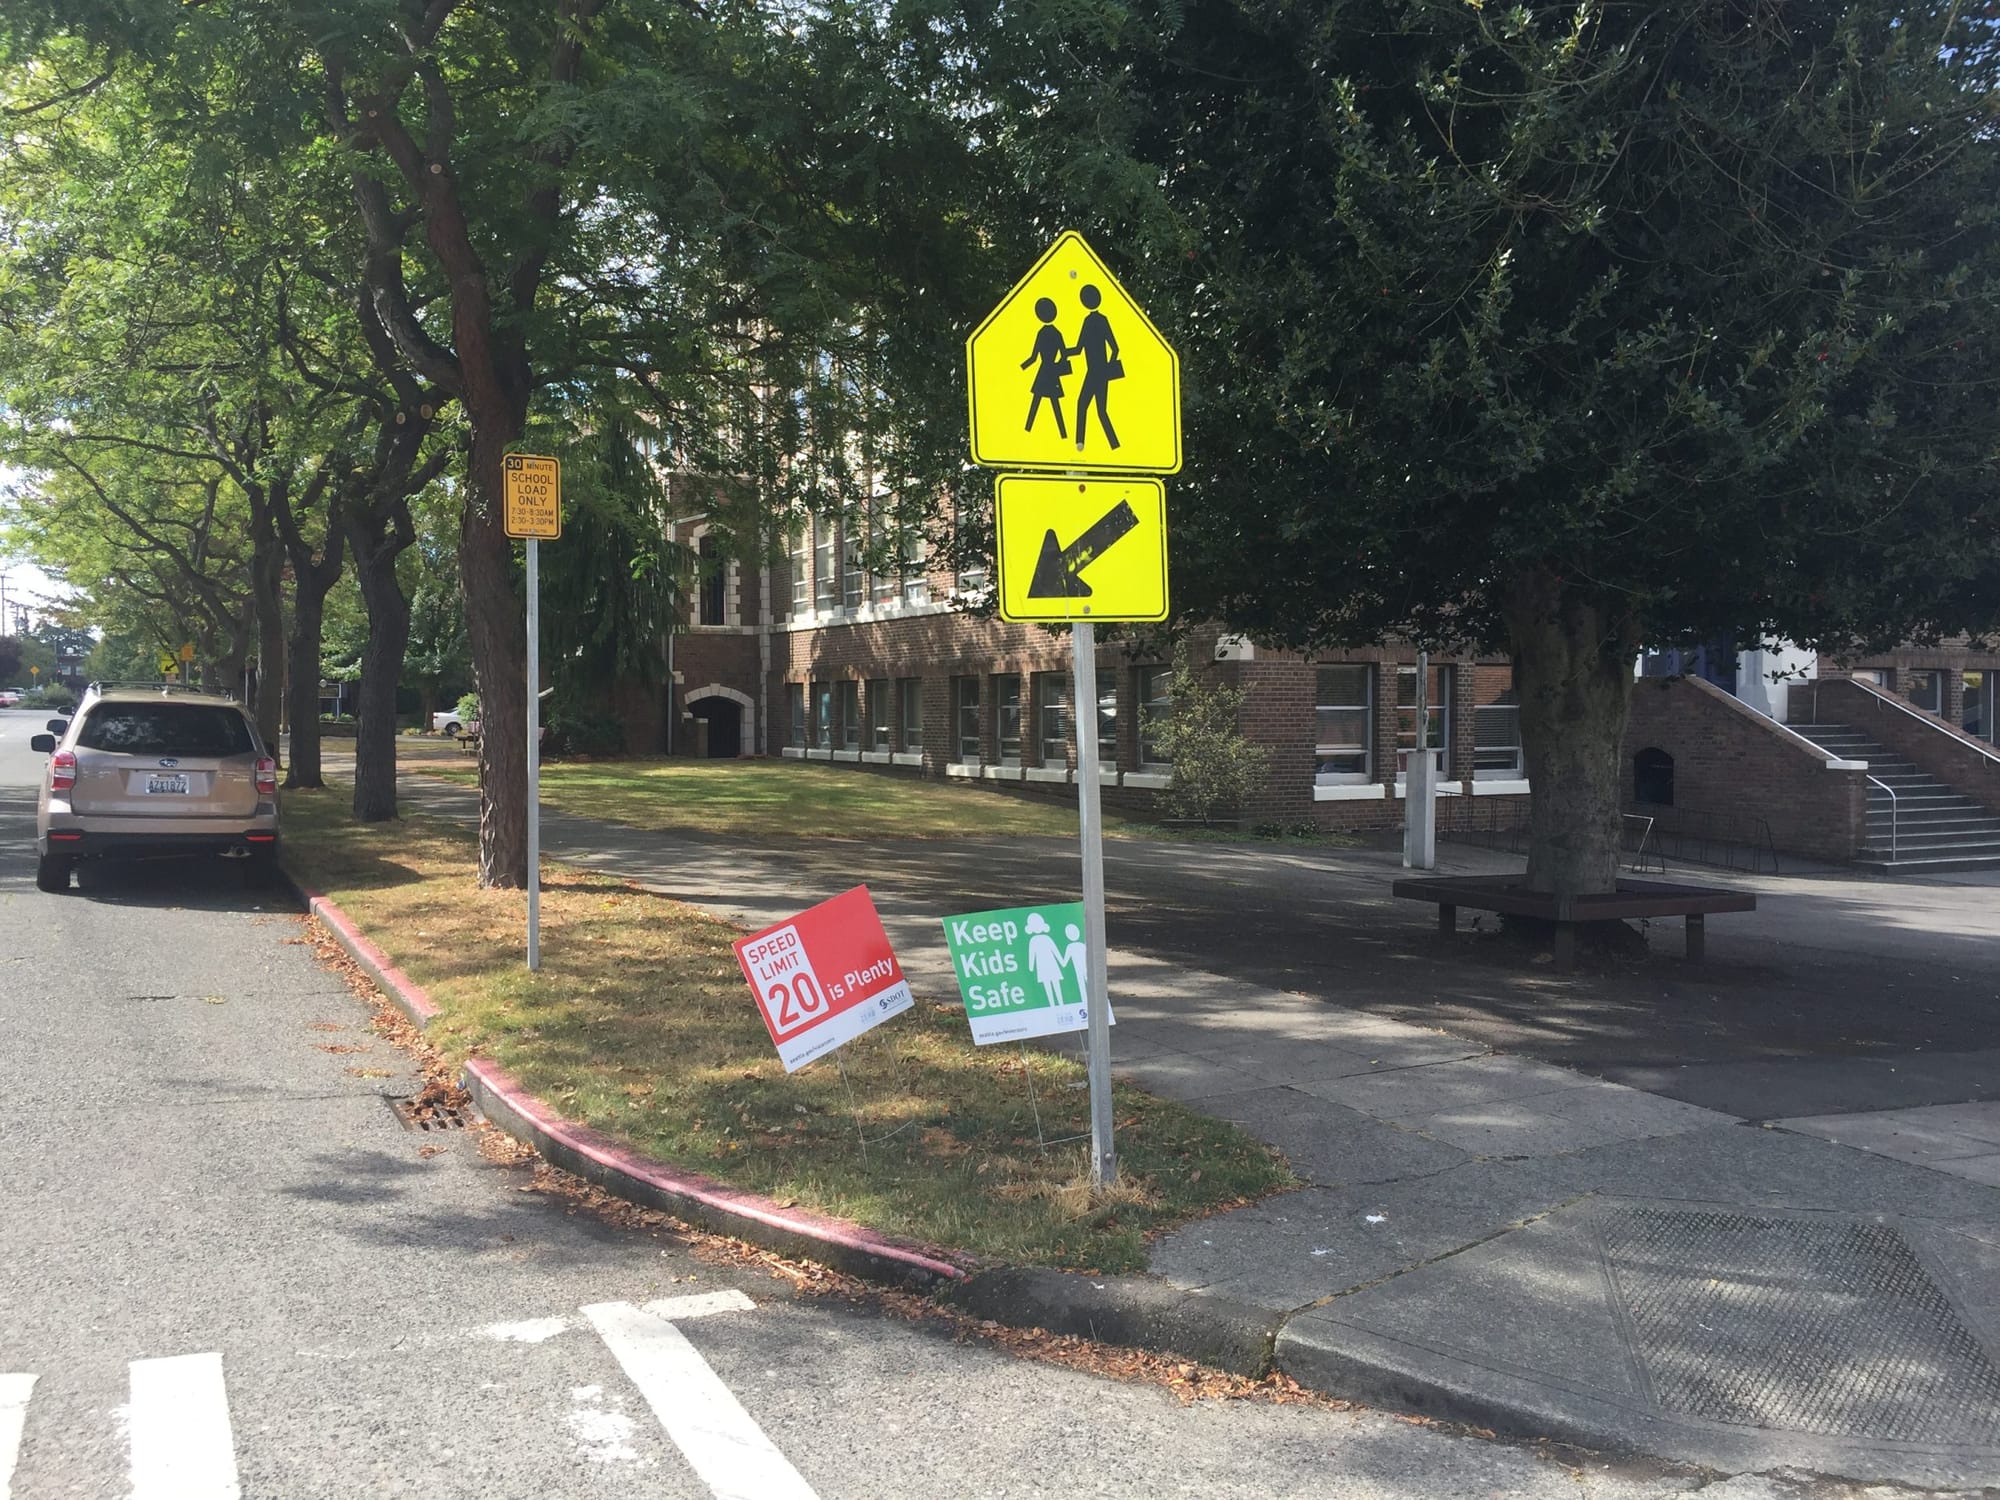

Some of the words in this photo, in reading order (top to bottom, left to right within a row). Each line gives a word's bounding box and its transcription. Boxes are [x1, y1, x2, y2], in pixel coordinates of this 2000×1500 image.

[507, 458, 522, 469] 30
[526, 463, 553, 471] MINUTE
[511, 472, 553, 485] SCHOOL
[518, 484, 547, 495] LOAD
[518, 495, 547, 507] ONLY
[951, 920, 1018, 946] Keep
[748, 932, 797, 964] SPEED
[759, 951, 800, 981] LIMIT
[960, 949, 1018, 978] Kids
[768, 972, 820, 1028] 20
[826, 983, 845, 1001] is
[844, 957, 894, 993] Plenty
[968, 981, 1026, 1011] Safe
